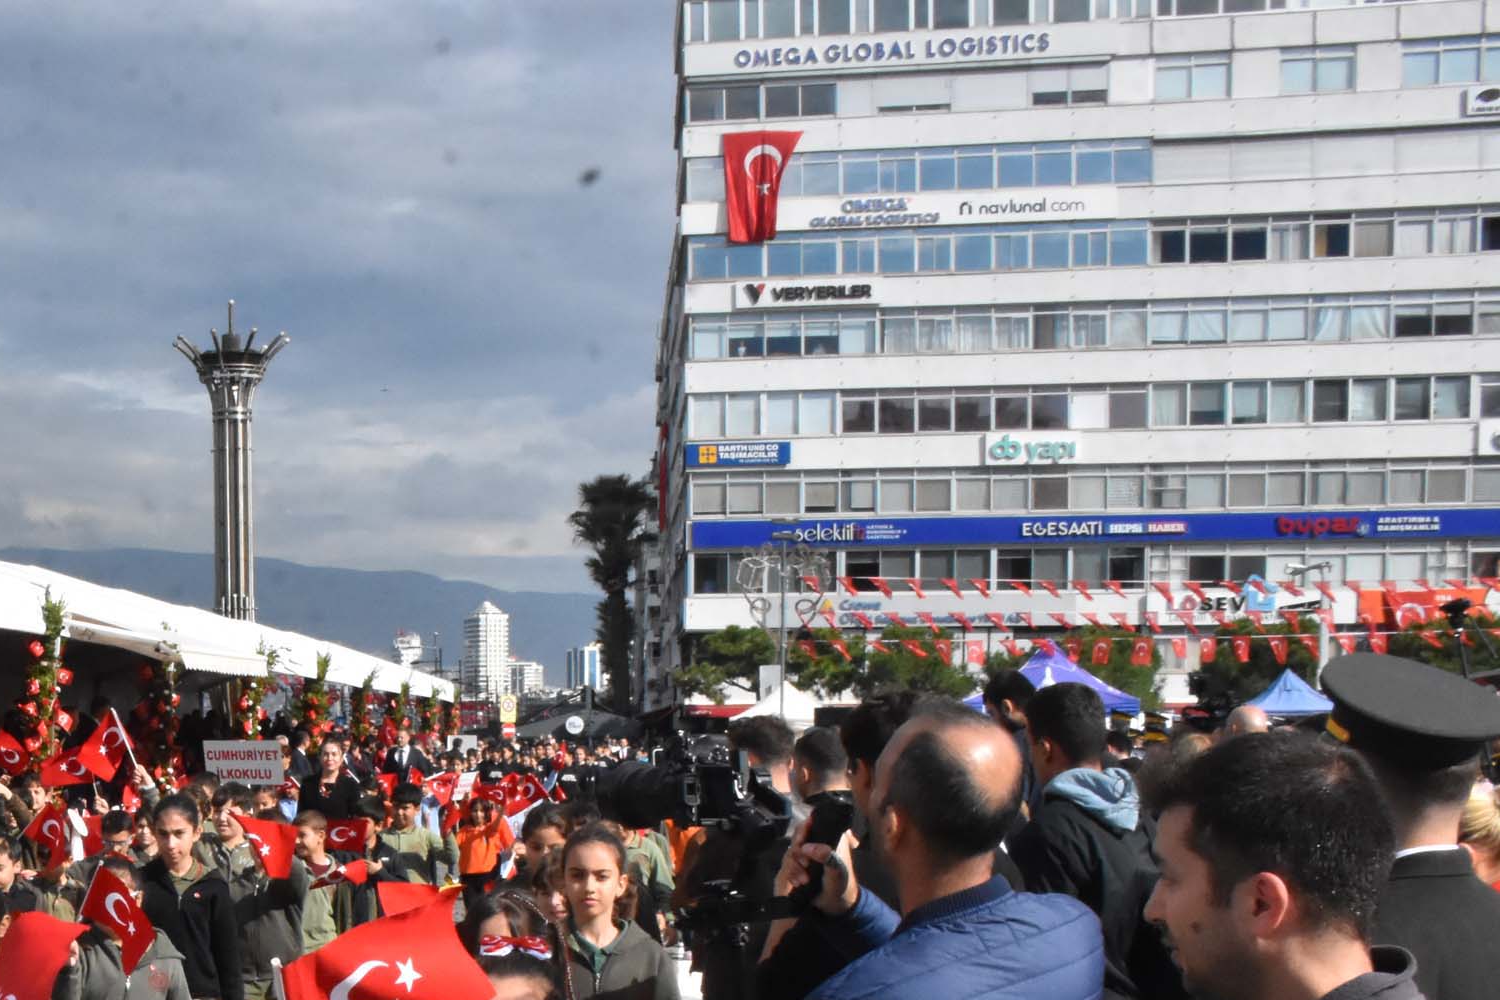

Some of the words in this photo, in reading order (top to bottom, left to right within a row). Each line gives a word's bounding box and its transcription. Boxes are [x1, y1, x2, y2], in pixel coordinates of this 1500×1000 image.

[734, 47, 818, 67] OMEGA
[823, 40, 915, 63] GLOBAL
[925, 33, 1050, 58] LOGISTICS
[810, 214, 863, 227] GLOBAL
[866, 212, 940, 225] LOGISTICS
[206, 747, 279, 761] CUMHURİYET
[216, 767, 272, 780] İLKOKULU
